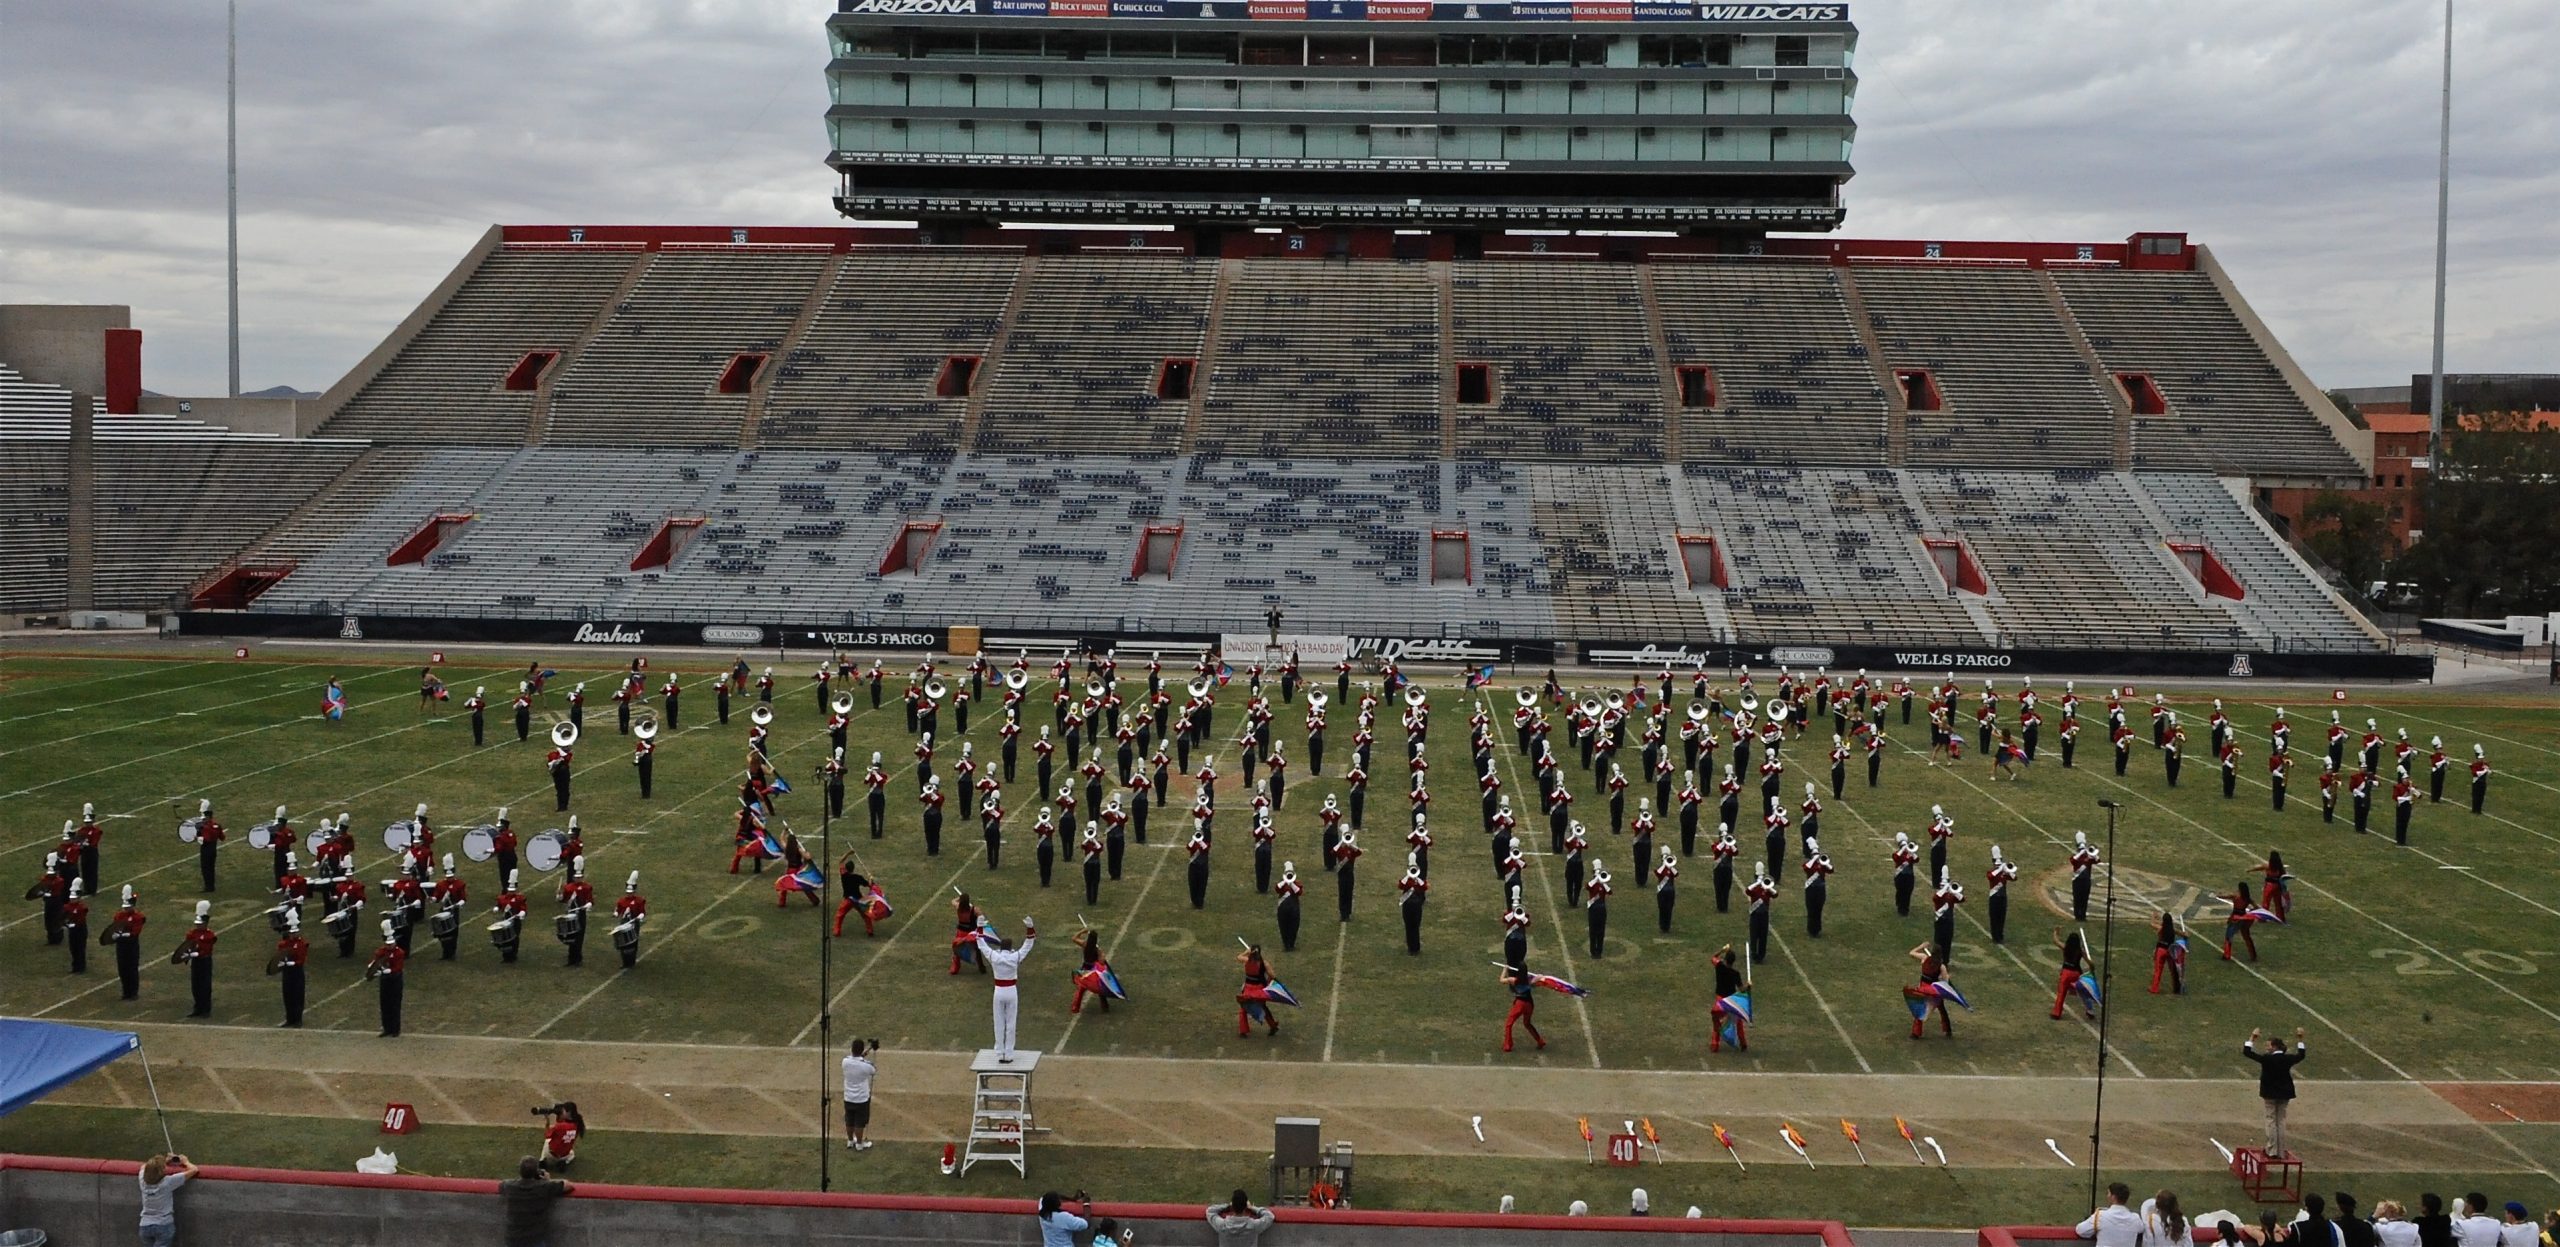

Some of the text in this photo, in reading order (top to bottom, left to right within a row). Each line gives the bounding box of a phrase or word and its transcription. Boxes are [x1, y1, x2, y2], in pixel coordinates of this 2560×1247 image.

[852, 0, 976, 13] ARIZONA
[1002, 2, 1016, 10] ART
[1017, 2, 1046, 10] LUPPINO
[1059, 2, 1080, 11] RICKY
[1119, 3, 1143, 12] CHUCK
[1145, 4, 1163, 12] CECIL
[1254, 6, 1284, 14] DARRYLL
[1286, 6, 1306, 14] LEWIS
[1521, 7, 1537, 15] STEVE
[1538, 7, 1572, 15] McLAUGHLIN
[1580, 7, 1598, 15] CHRIS
[1599, 7, 1632, 15] McALISTER
[1639, 8, 1667, 16] ANTOINE
[1669, 8, 1691, 16] CASON
[1701, 6, 1840, 19] WILDCATS
[571, 233, 582, 242] 17
[734, 234, 745, 243] 18
[1130, 238, 1144, 247] 20
[1291, 239, 1302, 249] 21
[1533, 243, 1546, 252] 22
[1926, 249, 1939, 258] 24
[2078, 251, 2092, 261] 25
[180, 403, 191, 411] 16
[573, 623, 645, 643] Bashas'
[822, 632, 935, 646] WELLS FARGO
[1308, 644, 1328, 653] BAND
[1330, 644, 1345, 654] DAY
[1895, 653, 2012, 667] WELLS FARGO
[384, 1107, 405, 1130] 40
[1613, 1139, 1633, 1162] 40
